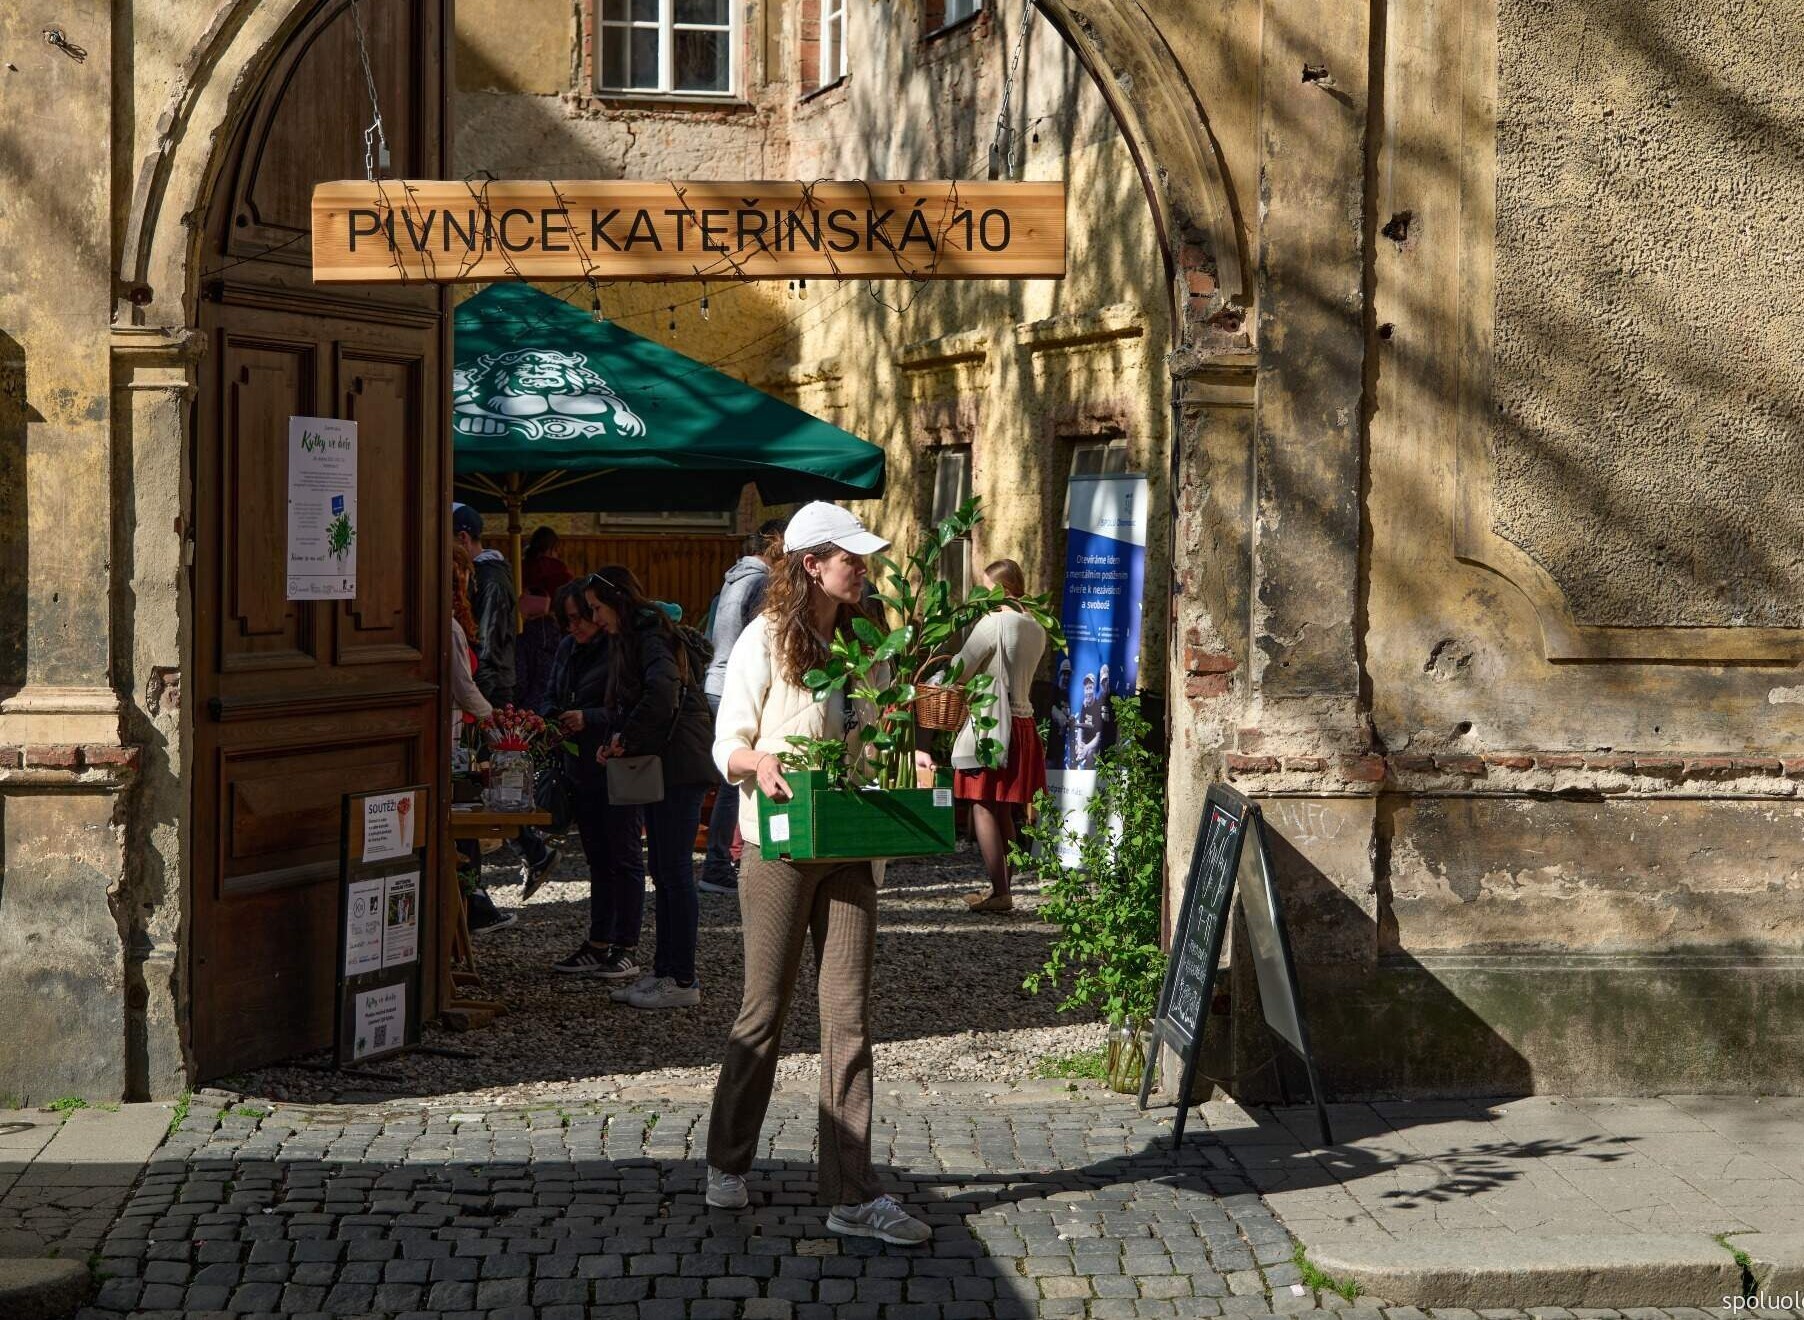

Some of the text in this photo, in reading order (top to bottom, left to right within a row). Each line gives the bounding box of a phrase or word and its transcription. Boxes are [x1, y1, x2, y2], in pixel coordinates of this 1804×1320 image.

[348, 199, 1011, 252] PIVNICE KATEŘINSKÁ 10
